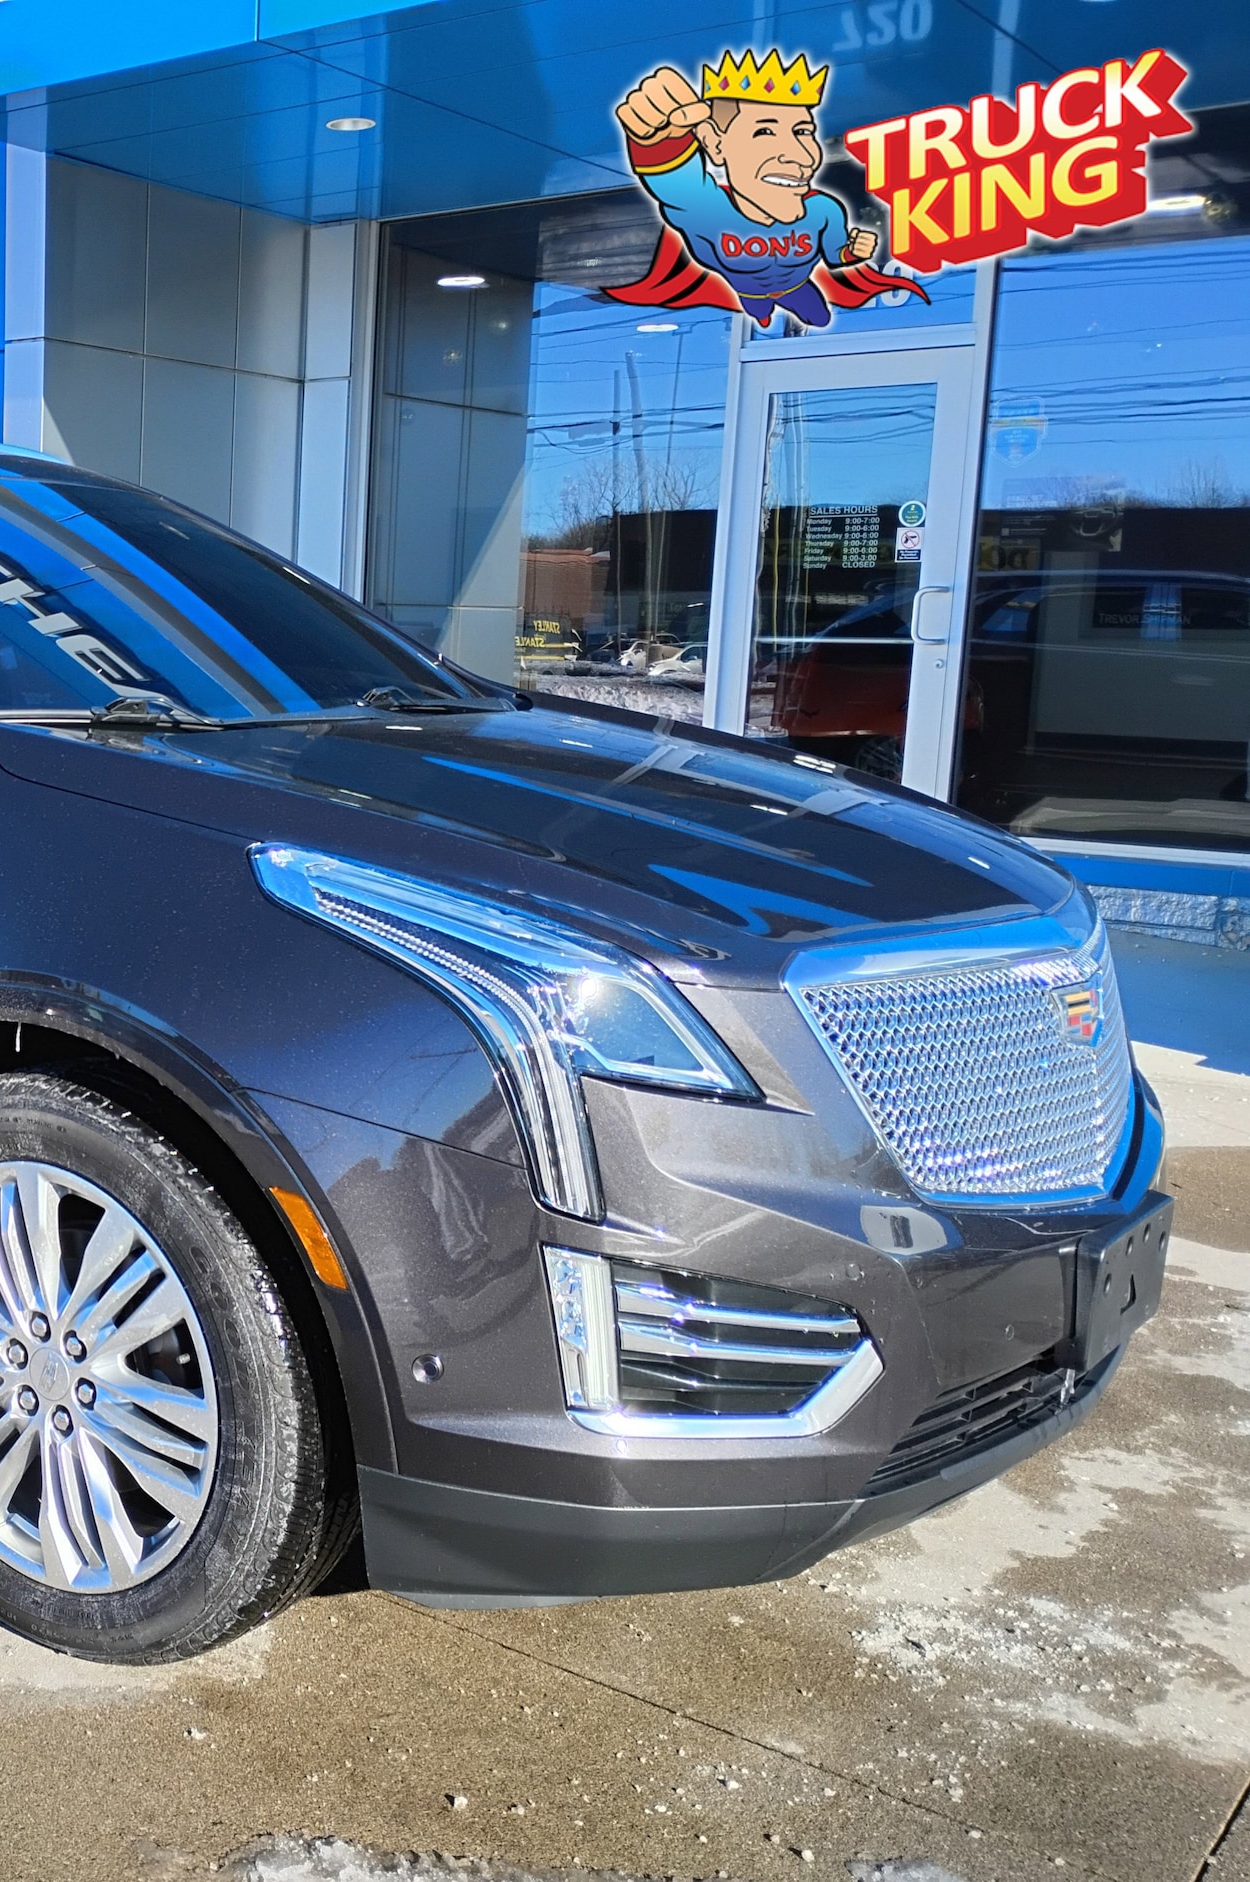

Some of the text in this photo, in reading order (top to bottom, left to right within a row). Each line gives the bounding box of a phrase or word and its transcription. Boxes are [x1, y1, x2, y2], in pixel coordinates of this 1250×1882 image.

[810, 505, 878, 515] SALES HOURS
[803, 562, 827, 570] Sunday
[1099, 612, 1140, 625] TREVOR
